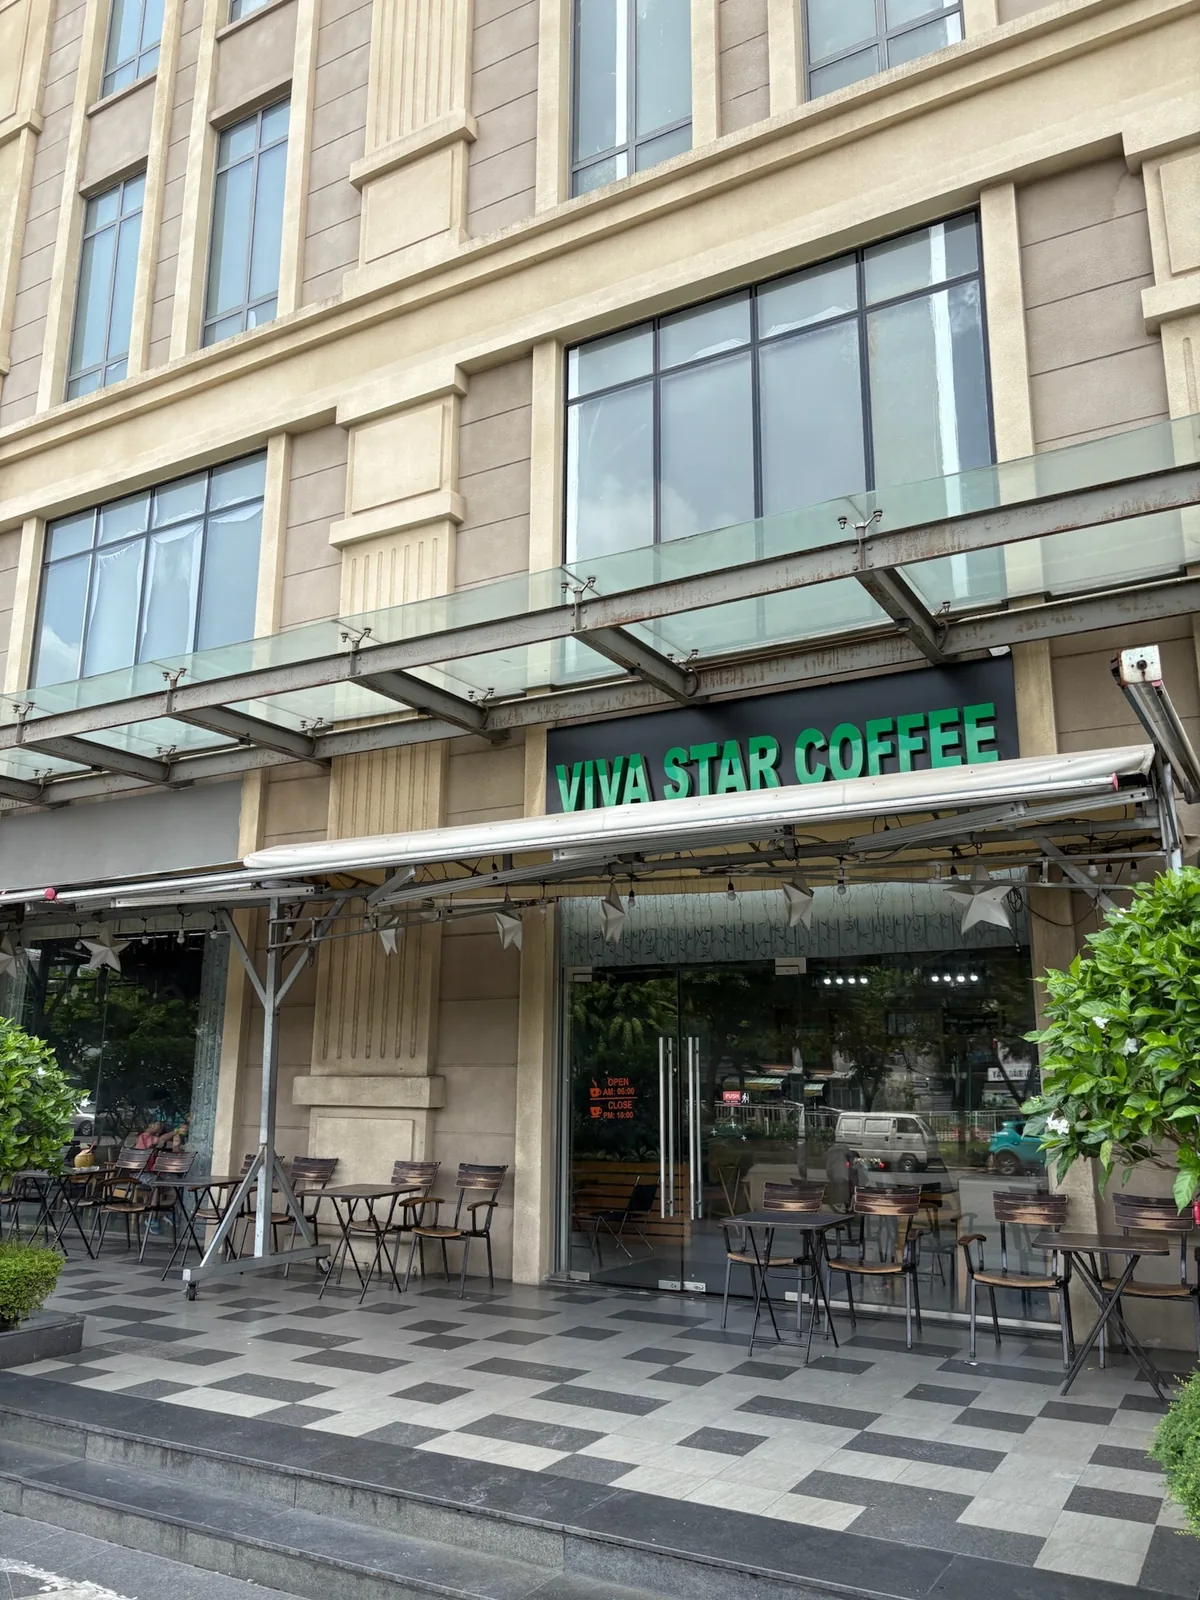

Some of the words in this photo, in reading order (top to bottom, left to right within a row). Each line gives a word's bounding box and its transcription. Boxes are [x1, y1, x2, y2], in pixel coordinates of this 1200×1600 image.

[555, 753, 651, 813] VIVA
[662, 735, 782, 801] STAR
[794, 702, 999, 785] COFFEE
[608, 1077, 629, 1086] OPEN
[608, 1100, 632, 1109] CLOSE
